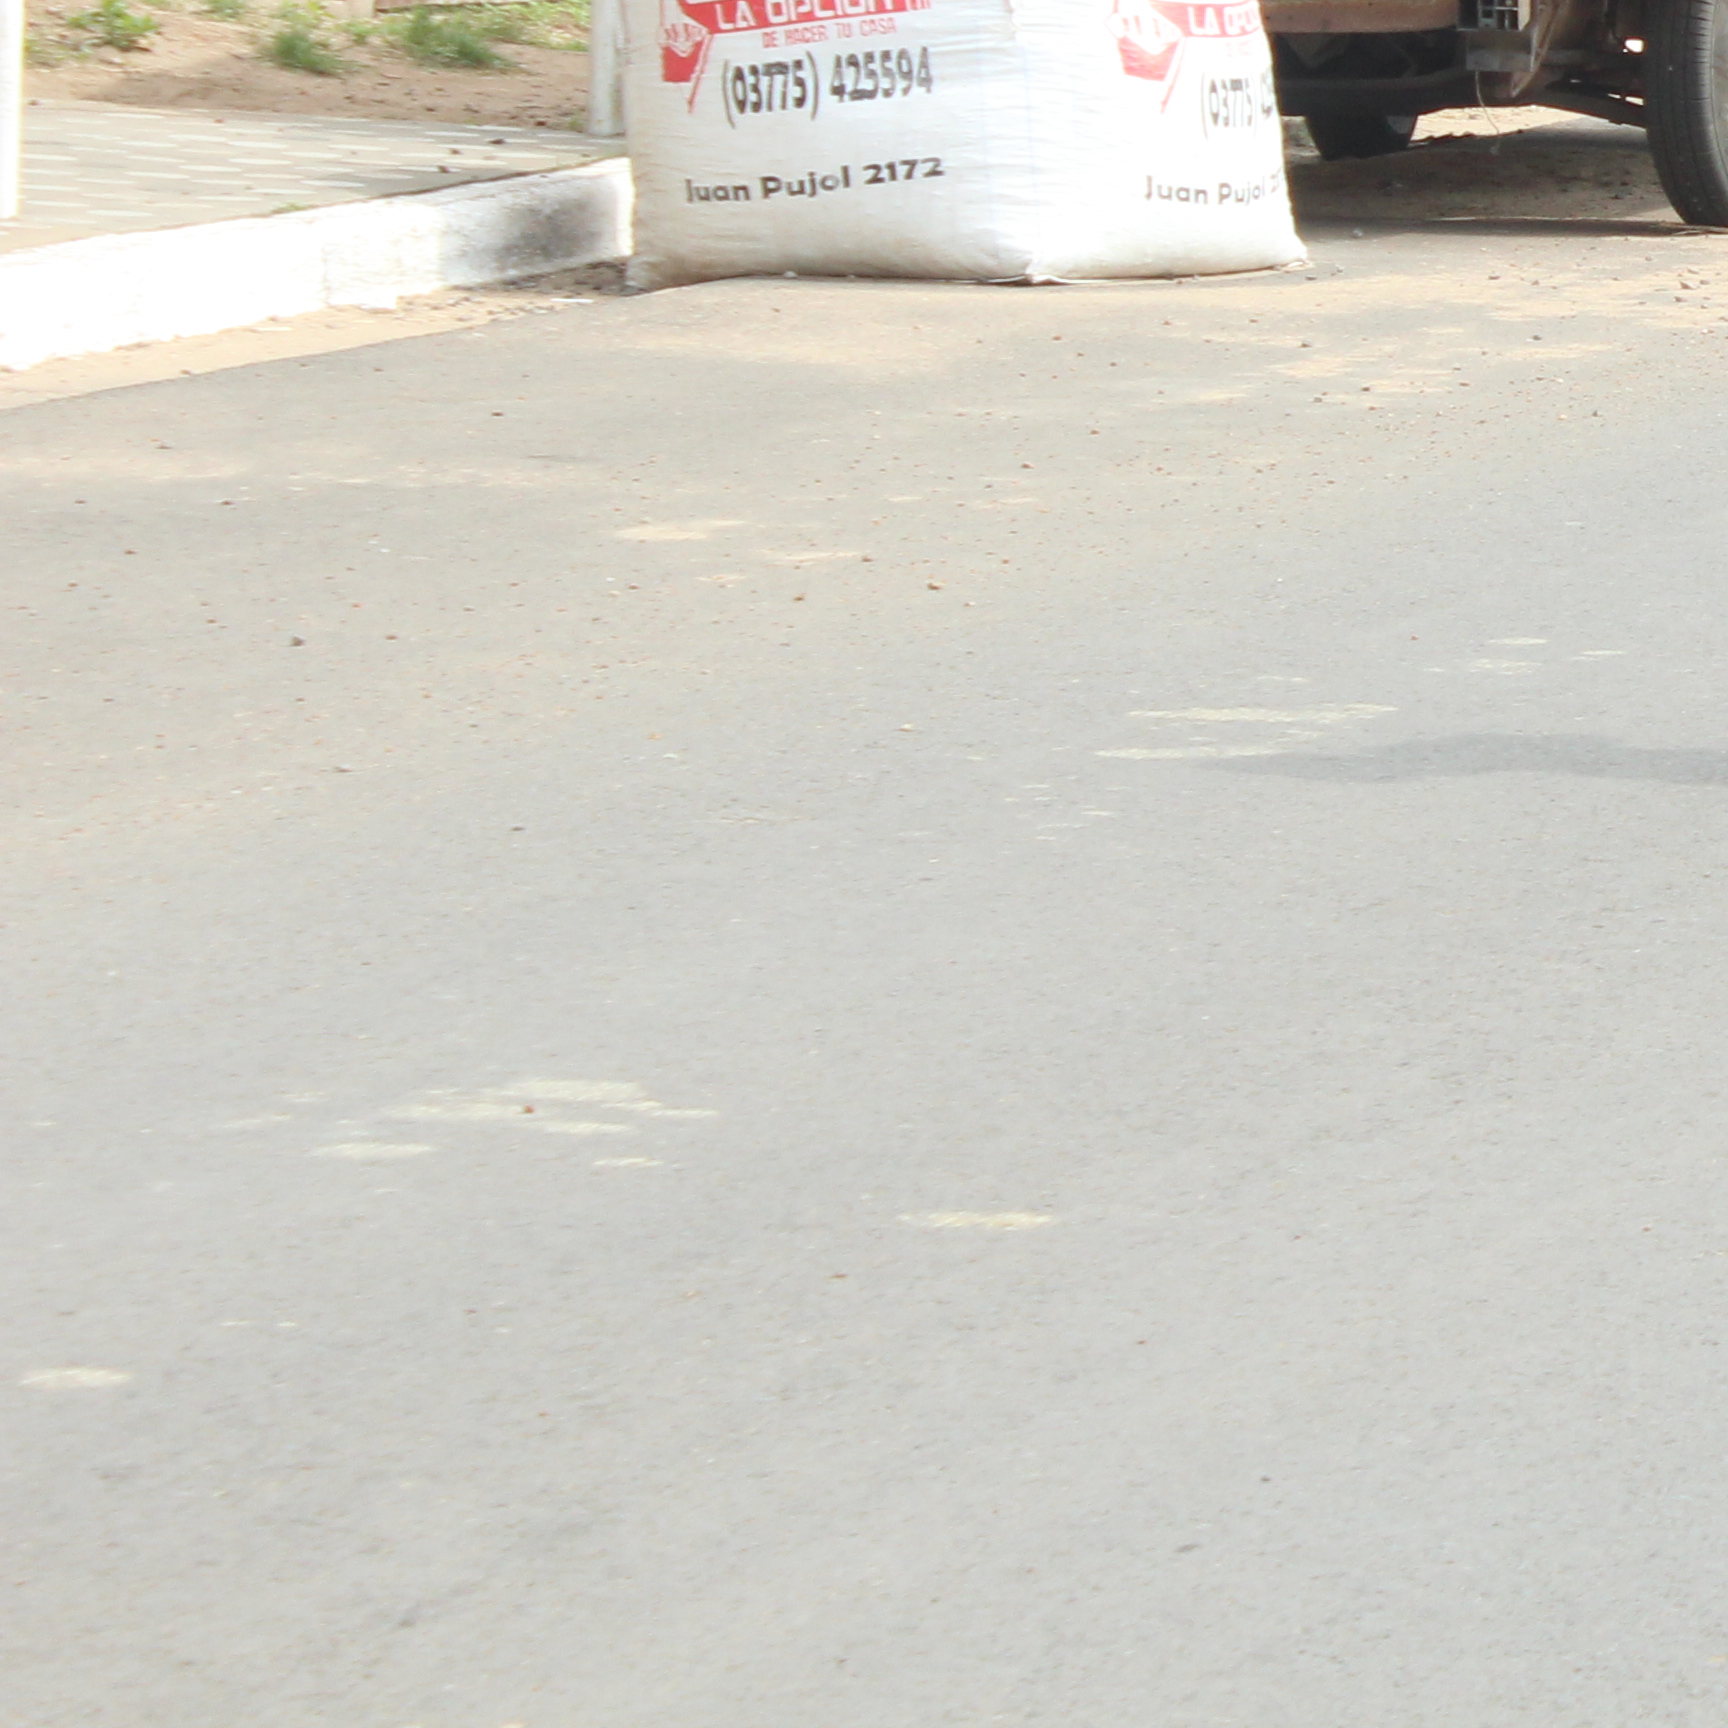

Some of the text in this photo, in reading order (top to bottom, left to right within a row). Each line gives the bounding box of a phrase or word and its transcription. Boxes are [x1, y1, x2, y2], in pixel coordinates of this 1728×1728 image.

[715, 0, 756, 30] LA
[1187, 6, 1220, 35] LA
[762, 17, 897, 48] DE HACER TU CASA
[722, 46, 933, 129] (03775) 425594
[685, 157, 946, 204] Juan Pujol 2172
[1144, 175, 1209, 205] Juan
[1217, 176, 1265, 207] Pujol
